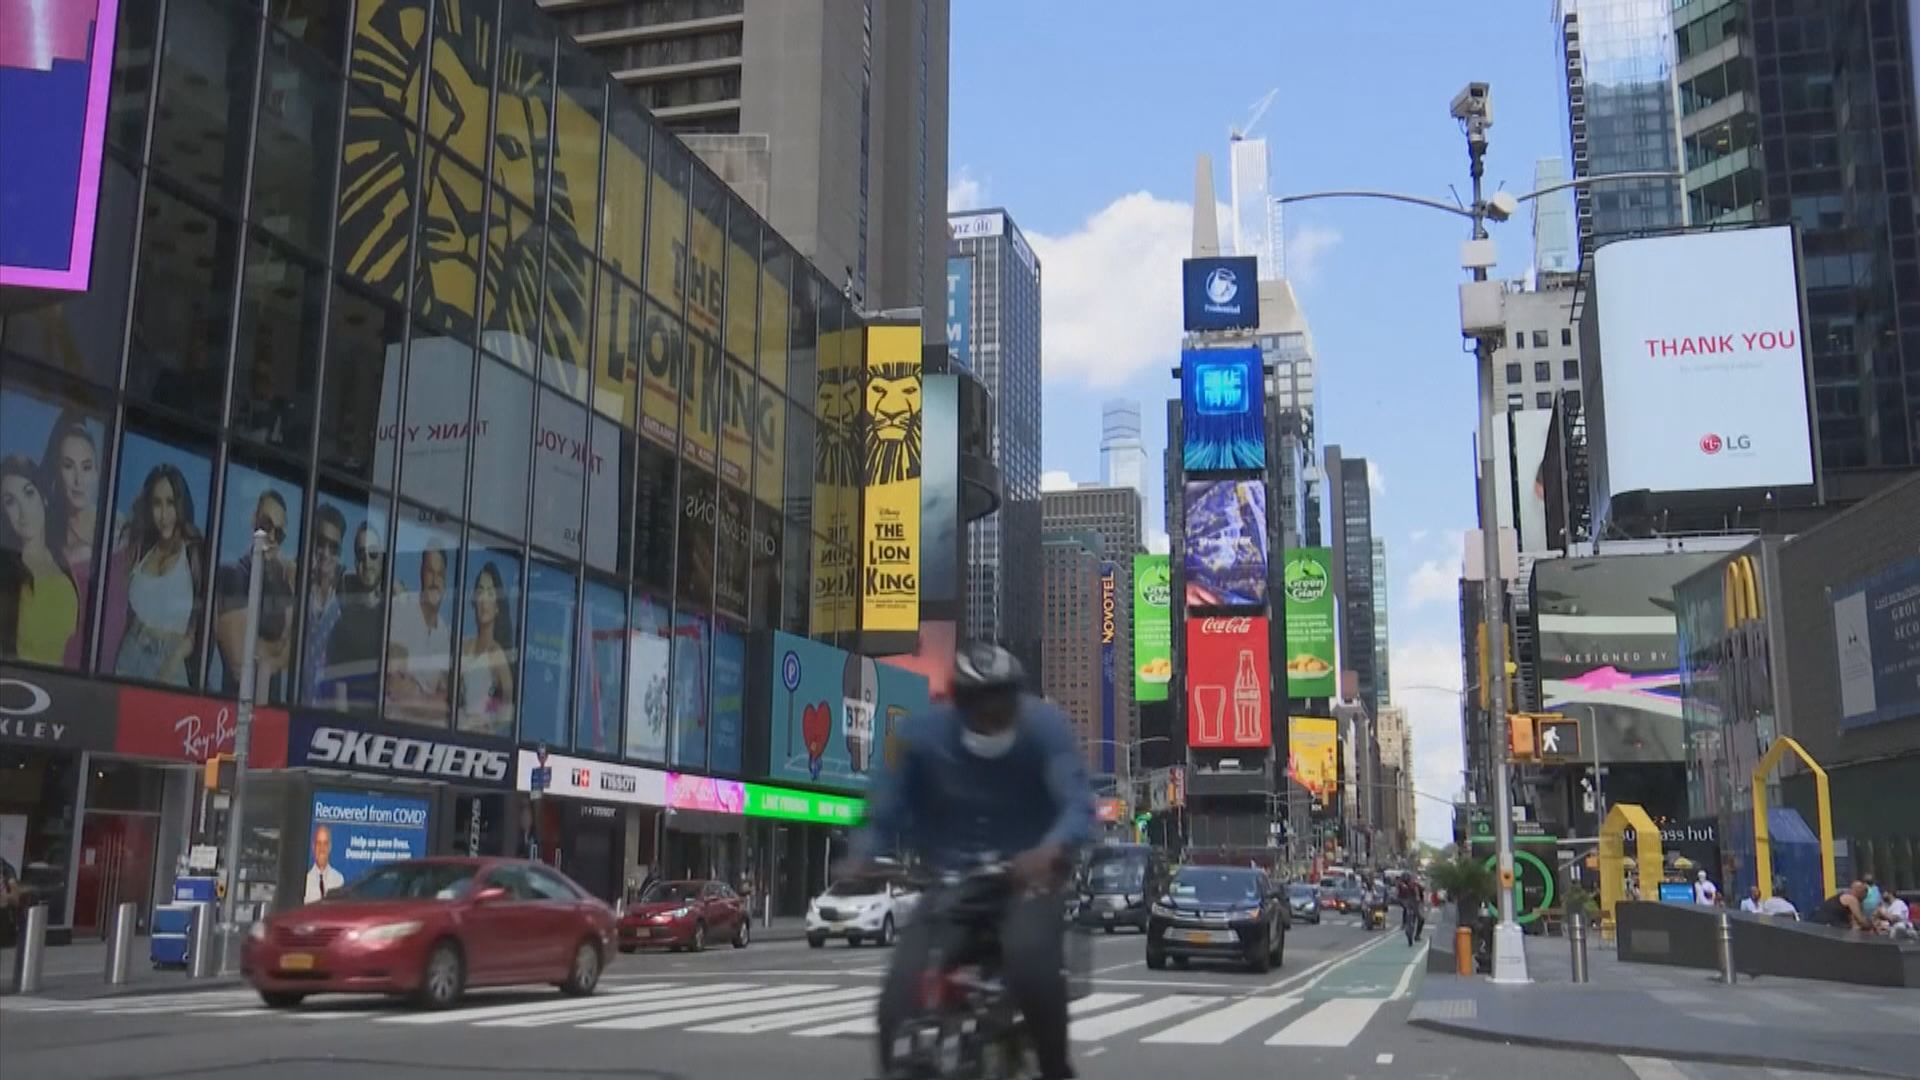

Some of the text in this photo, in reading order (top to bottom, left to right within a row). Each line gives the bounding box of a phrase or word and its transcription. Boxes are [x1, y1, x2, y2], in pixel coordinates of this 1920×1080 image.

[607, 257, 696, 401] LION
[1645, 329, 1796, 358] THANK YOU
[699, 328, 775, 452] KING
[1726, 434, 1751, 450] LG
[875, 523, 905, 539] THE
[869, 540, 911, 566] LION
[866, 567, 917, 596] KING
[1101, 571, 1115, 645] NOVOTEL
[1565, 652, 1669, 664] DESIGNED BY
[174, 706, 239, 759] Ray-Ba
[306, 731, 511, 782] SKECHERS
[600, 773, 636, 793] TISSOT
[315, 803, 426, 825] Recovered from COVID?
[351, 835, 367, 849] Help
[1687, 826, 1714, 841] hut
[346, 848, 370, 860] Donate
